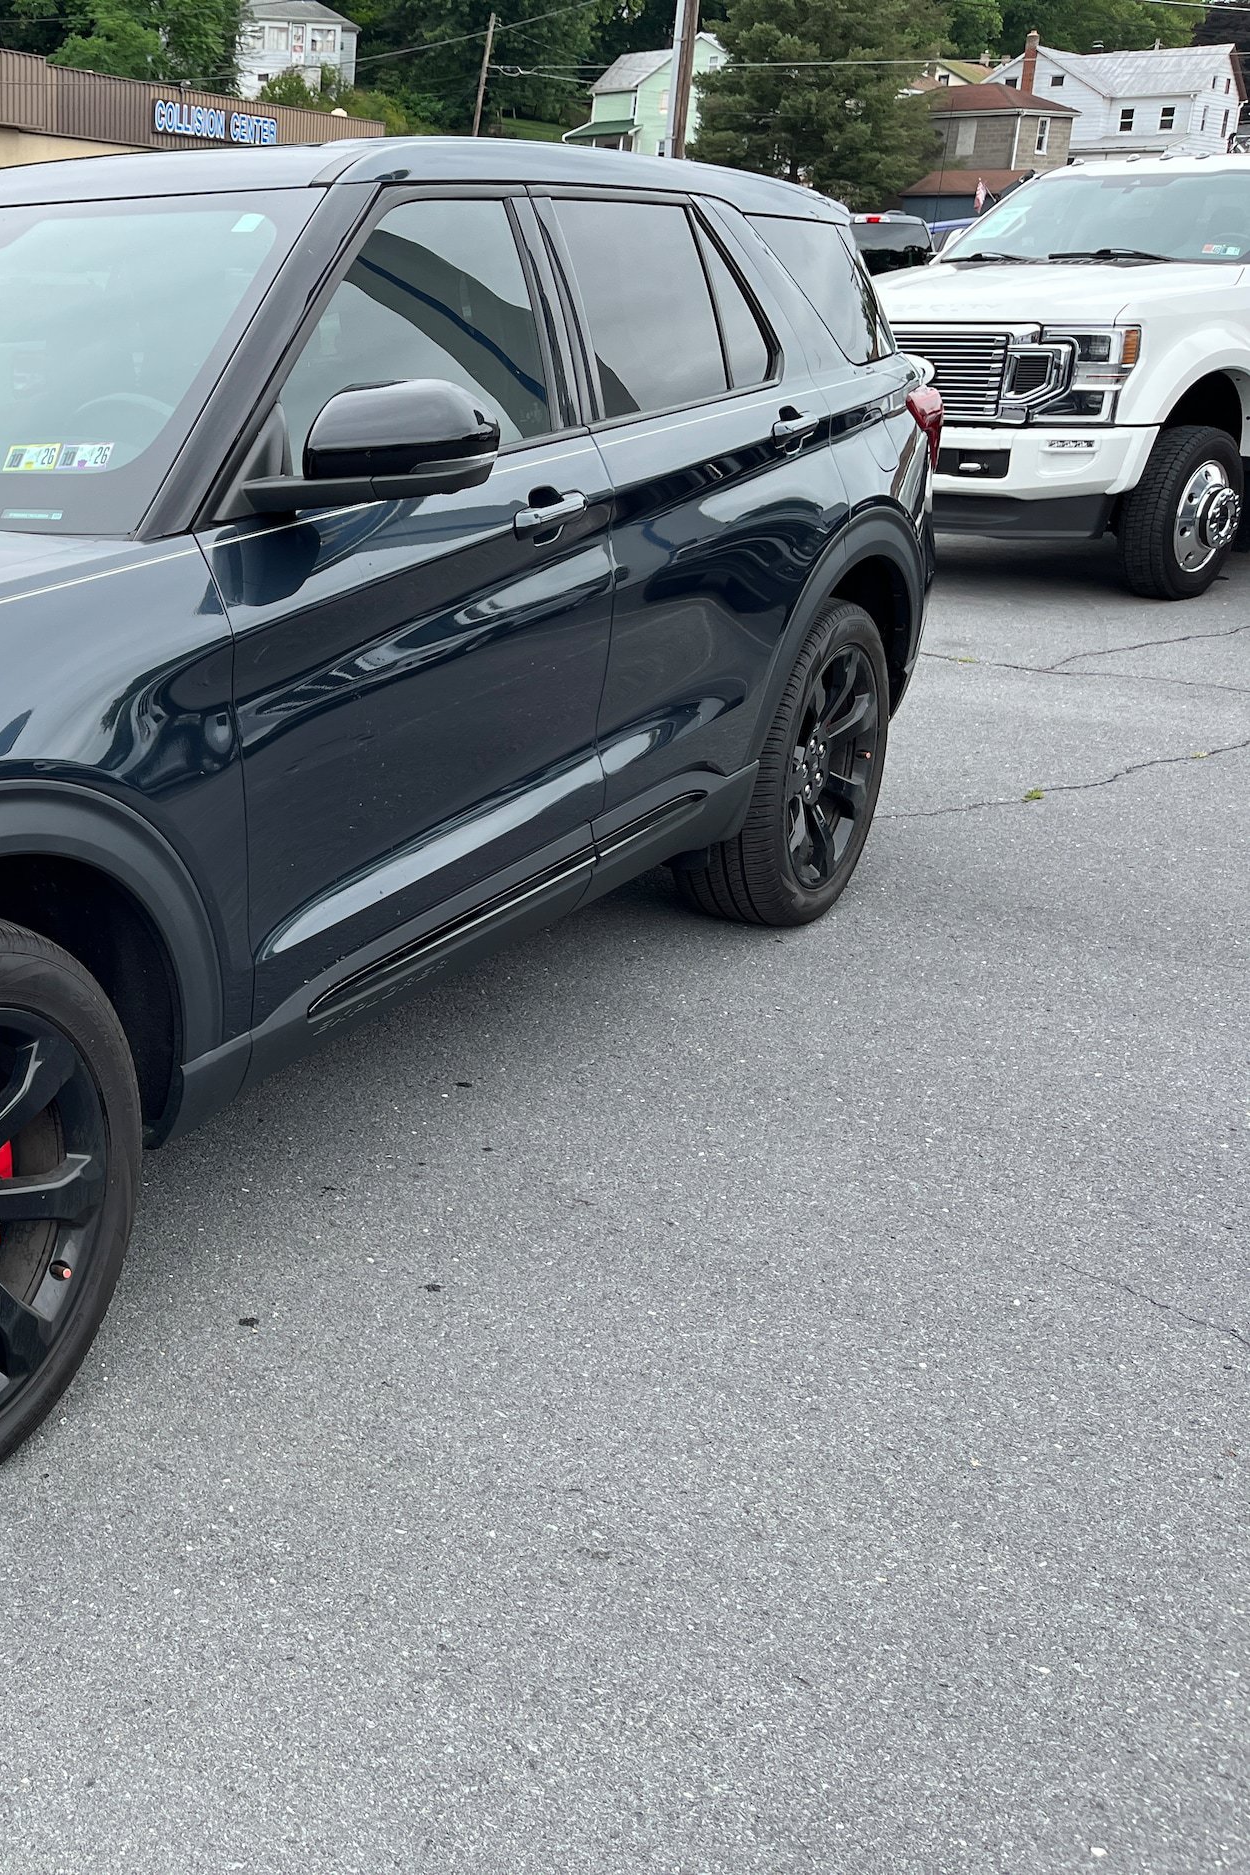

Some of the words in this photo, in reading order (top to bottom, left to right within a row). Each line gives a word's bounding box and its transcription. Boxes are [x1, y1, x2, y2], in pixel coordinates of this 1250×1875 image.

[154, 100, 225, 140] COLLISION
[230, 111, 277, 145] CENTER
[41, 448, 56, 465] 26
[93, 446, 110, 464] 26
